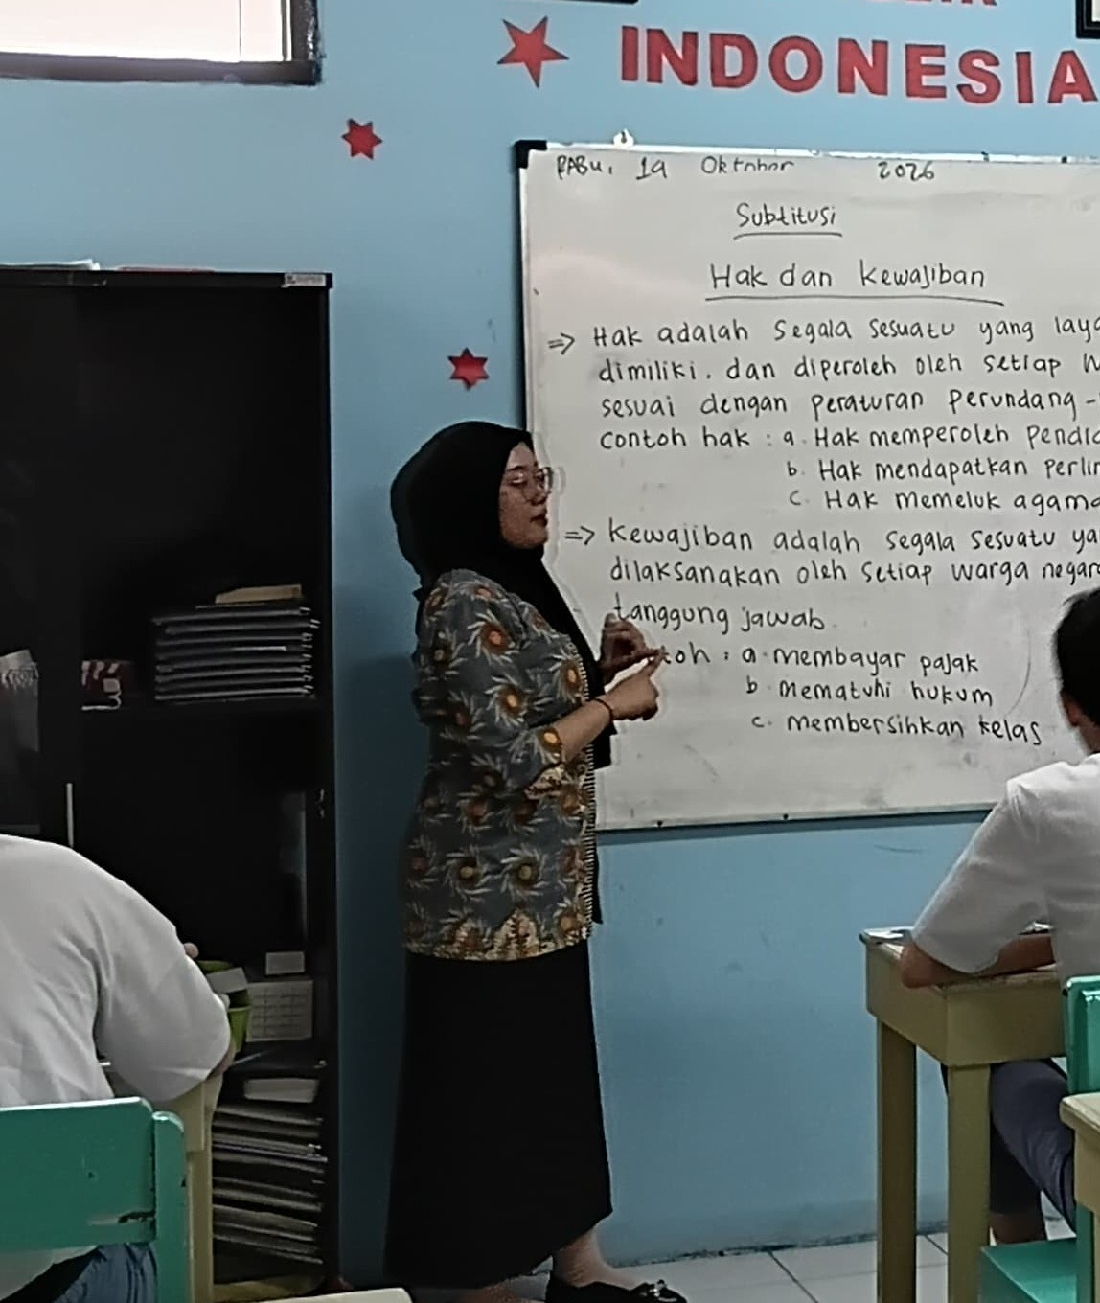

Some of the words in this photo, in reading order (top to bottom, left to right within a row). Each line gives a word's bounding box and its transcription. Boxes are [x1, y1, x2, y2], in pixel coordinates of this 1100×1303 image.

[620, 26, 1098, 105] INDONESIA
[710, 263, 768, 288] Hak
[779, 263, 832, 287] dan
[594, 327, 643, 347] Hak
[658, 319, 748, 343] adalah
[979, 319, 1033, 344] yang
[726, 357, 775, 380] dan
[794, 355, 896, 381] diperoleh
[916, 353, 962, 376] oleh
[700, 394, 788, 418] dengan
[811, 391, 923, 422] peraturan
[703, 425, 750, 448] hak
[814, 427, 860, 447] Hak
[870, 423, 1009, 449] memperoleh
[818, 459, 862, 481] Hak
[876, 457, 1028, 485] mendapatkan
[825, 489, 879, 509] Hak
[773, 529, 860, 554] adalah
[609, 556, 782, 586] dilaksanakan
[796, 558, 847, 584] oleh
[613, 592, 730, 635] tanggung
[909, 680, 993, 706] hukum
